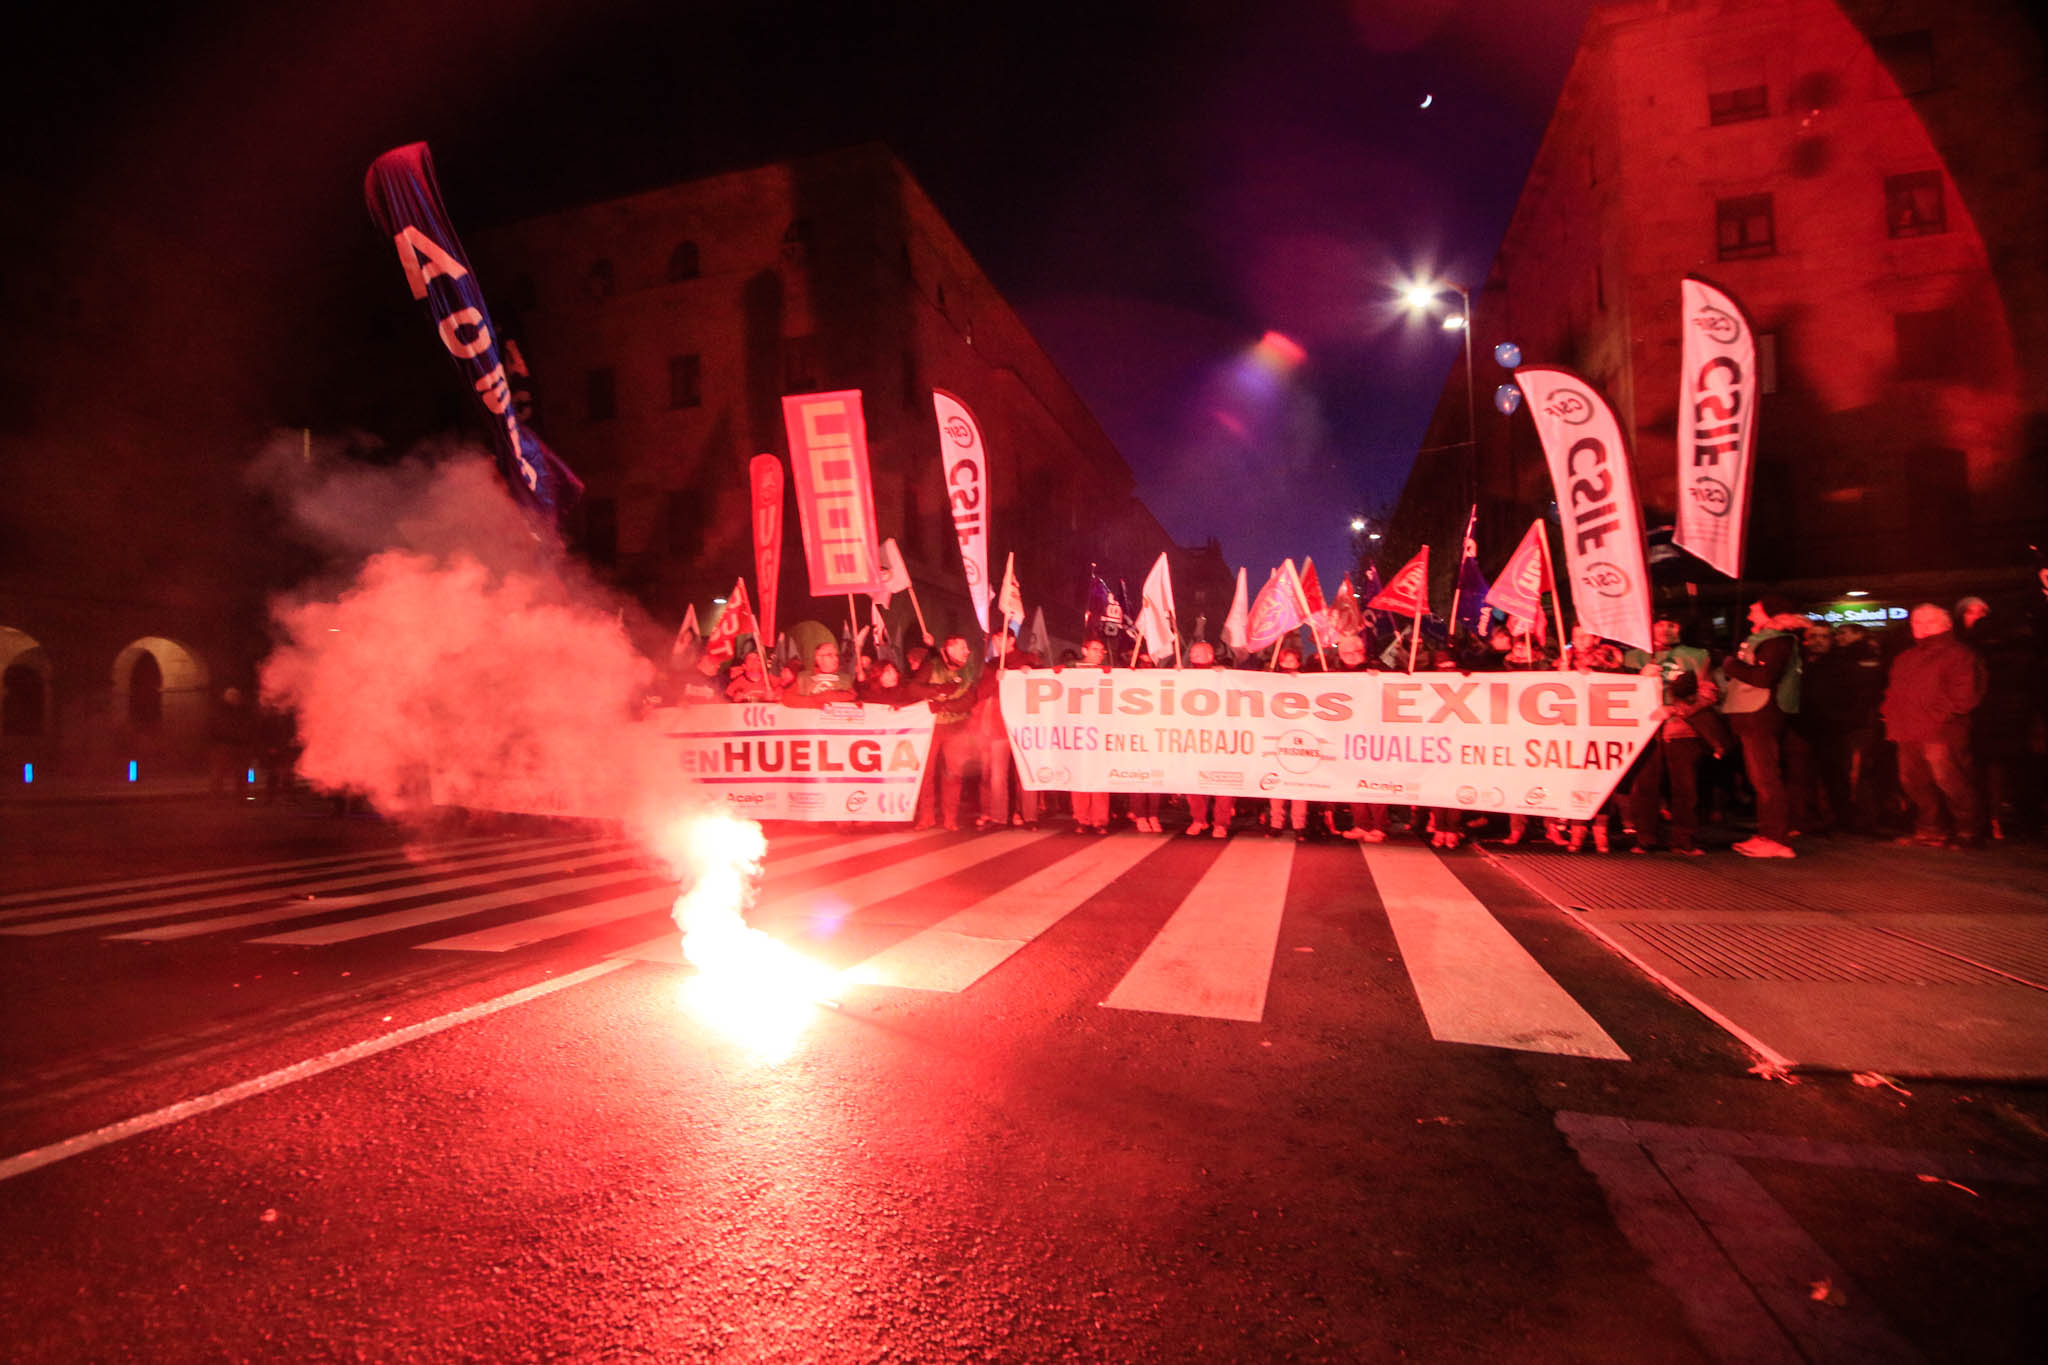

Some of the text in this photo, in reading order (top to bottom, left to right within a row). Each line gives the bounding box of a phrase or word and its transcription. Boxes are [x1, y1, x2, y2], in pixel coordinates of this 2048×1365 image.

[1025, 677, 1640, 727] Prisiones EXIGE
[681, 738, 921, 773] EN HUELGA
[1104, 733, 1125, 752] EN
[1130, 733, 1149, 753] EL
[1154, 727, 1254, 755] TRABAJO
[1344, 733, 1452, 764] IGUALES
[1461, 745, 1486, 766] EN
[1493, 746, 1516, 767] EL
